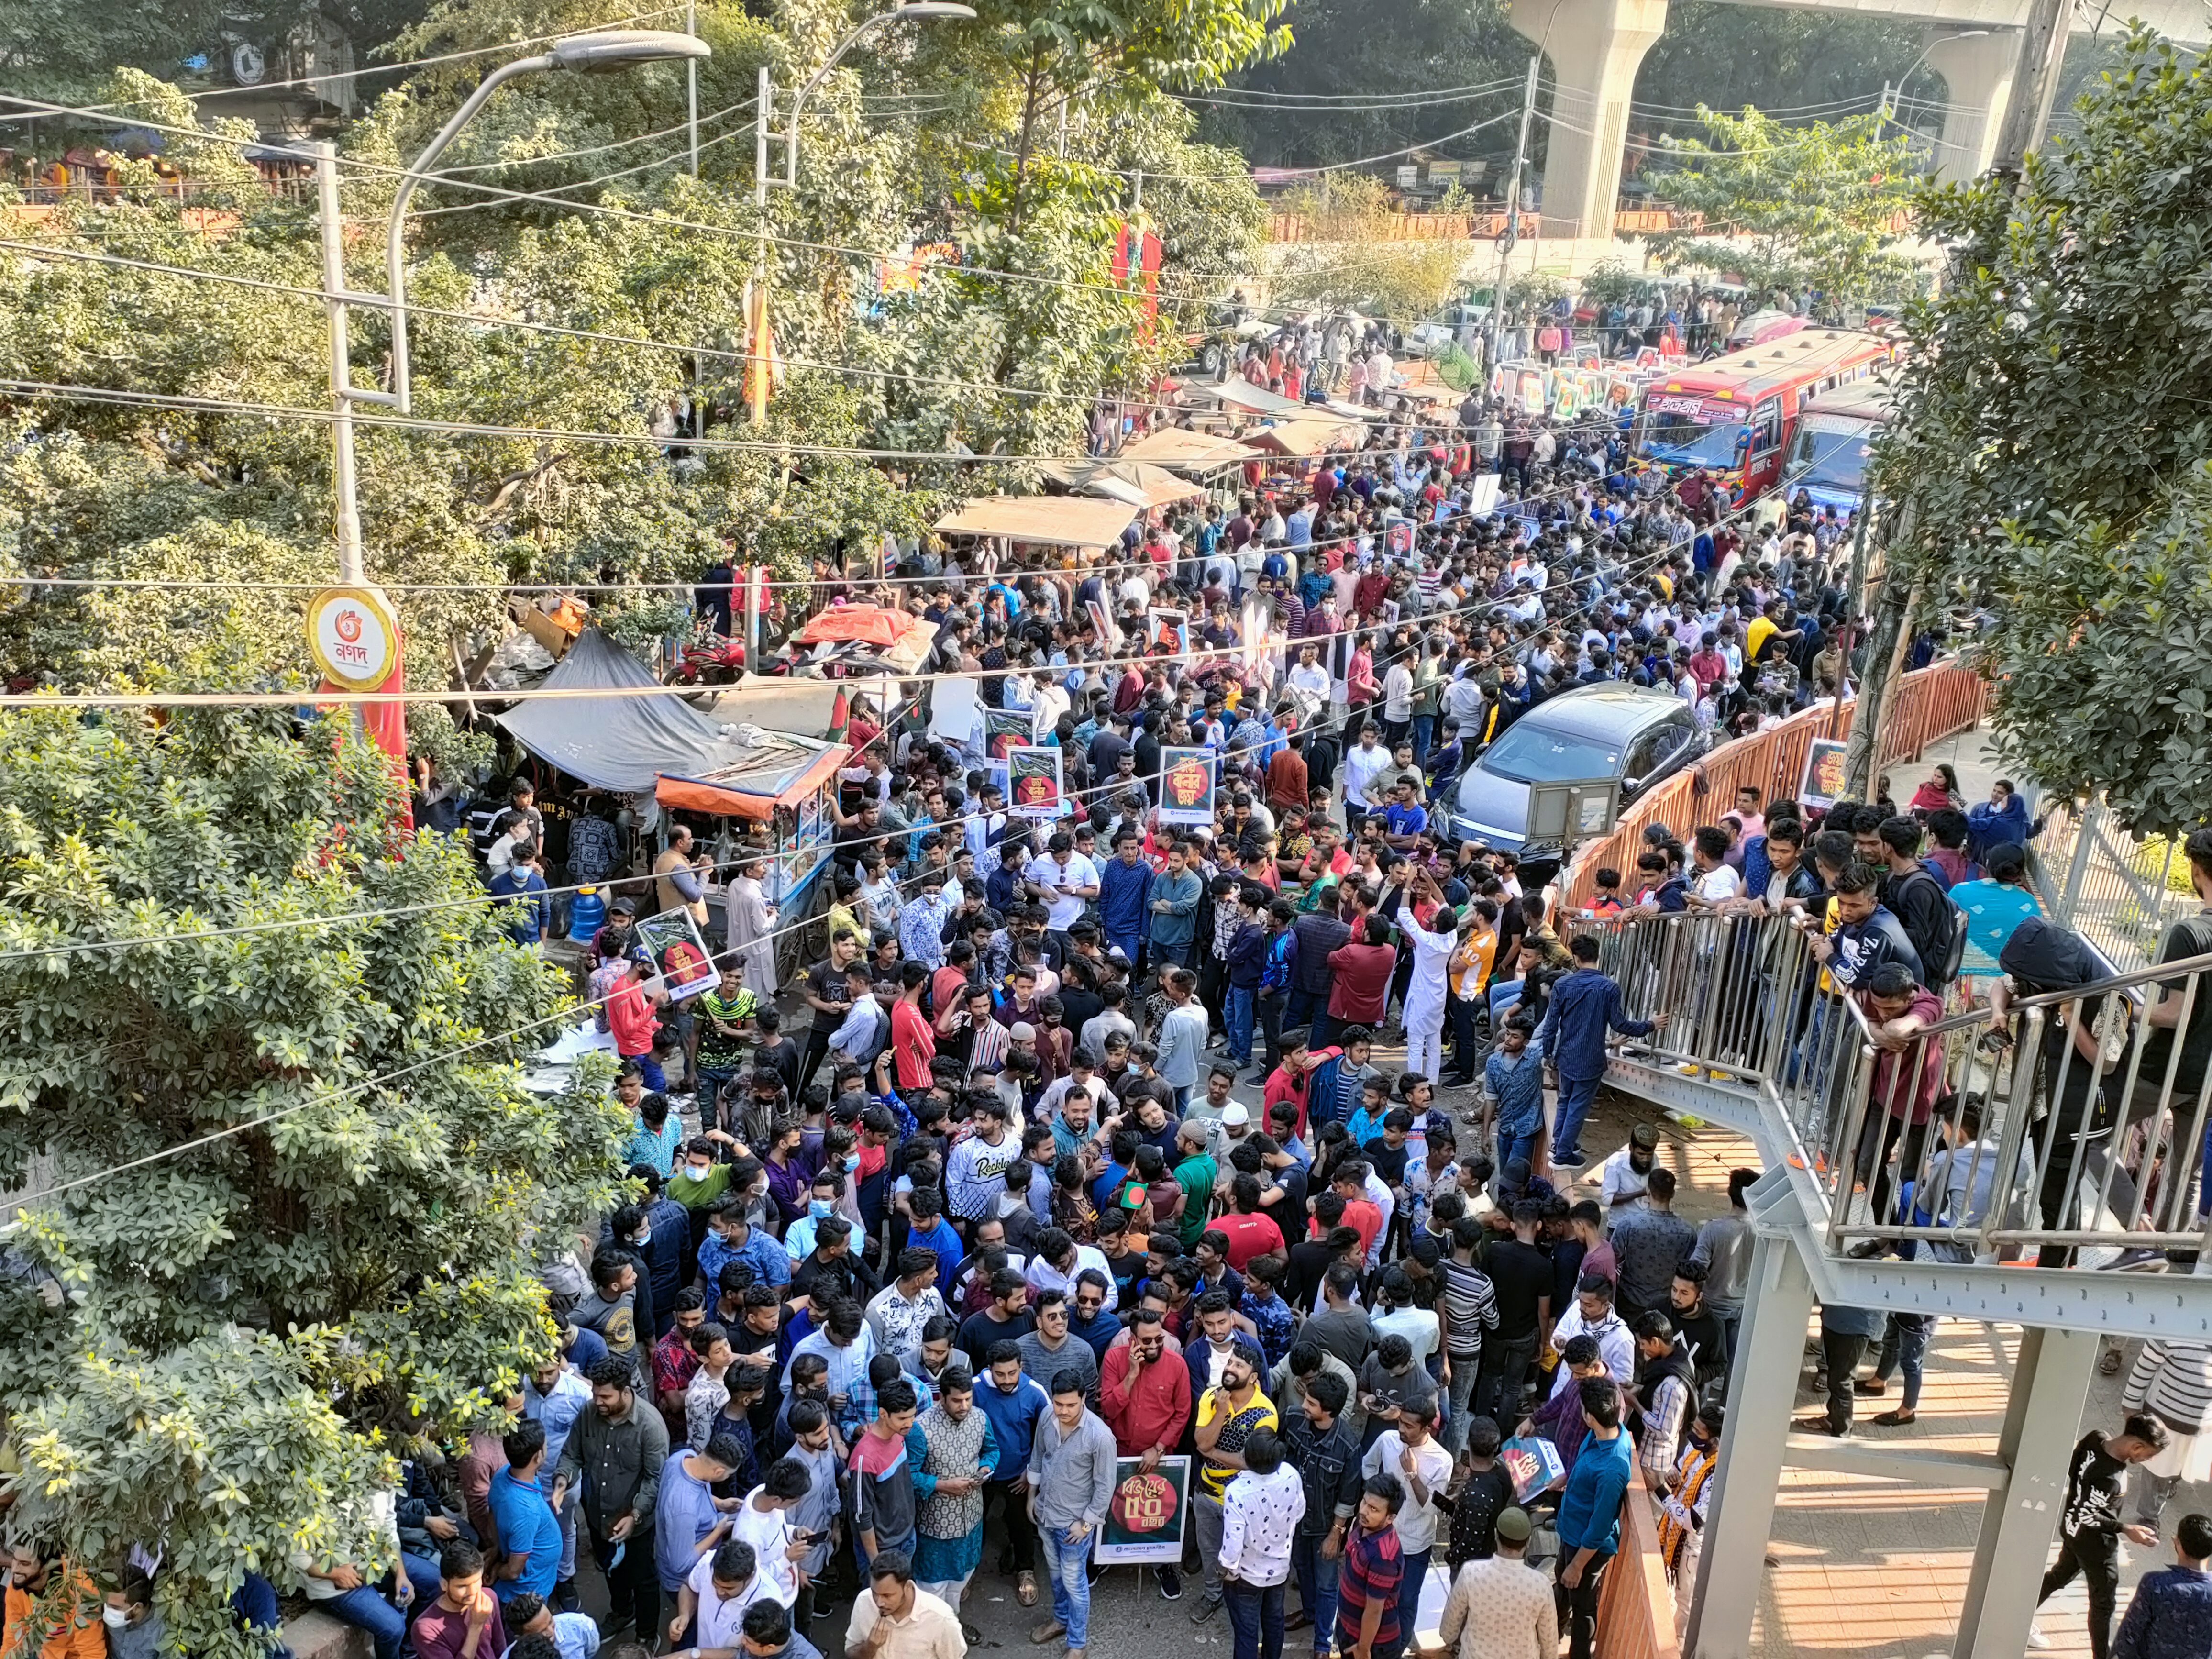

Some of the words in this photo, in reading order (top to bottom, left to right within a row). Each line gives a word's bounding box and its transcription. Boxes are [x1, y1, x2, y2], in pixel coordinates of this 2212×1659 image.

[1659, 396, 1703, 415] ইতিহাস
[333, 642, 368, 664] নগদ
[1173, 773, 1201, 789] বাংলার
[1178, 789, 1196, 806] জয়
[1465, 949, 1480, 962] 10
[1122, 1474, 1168, 1504] বিজয়ের
[1124, 1497, 1162, 1519] ৫০
[1141, 1516, 1166, 1528] বছর
